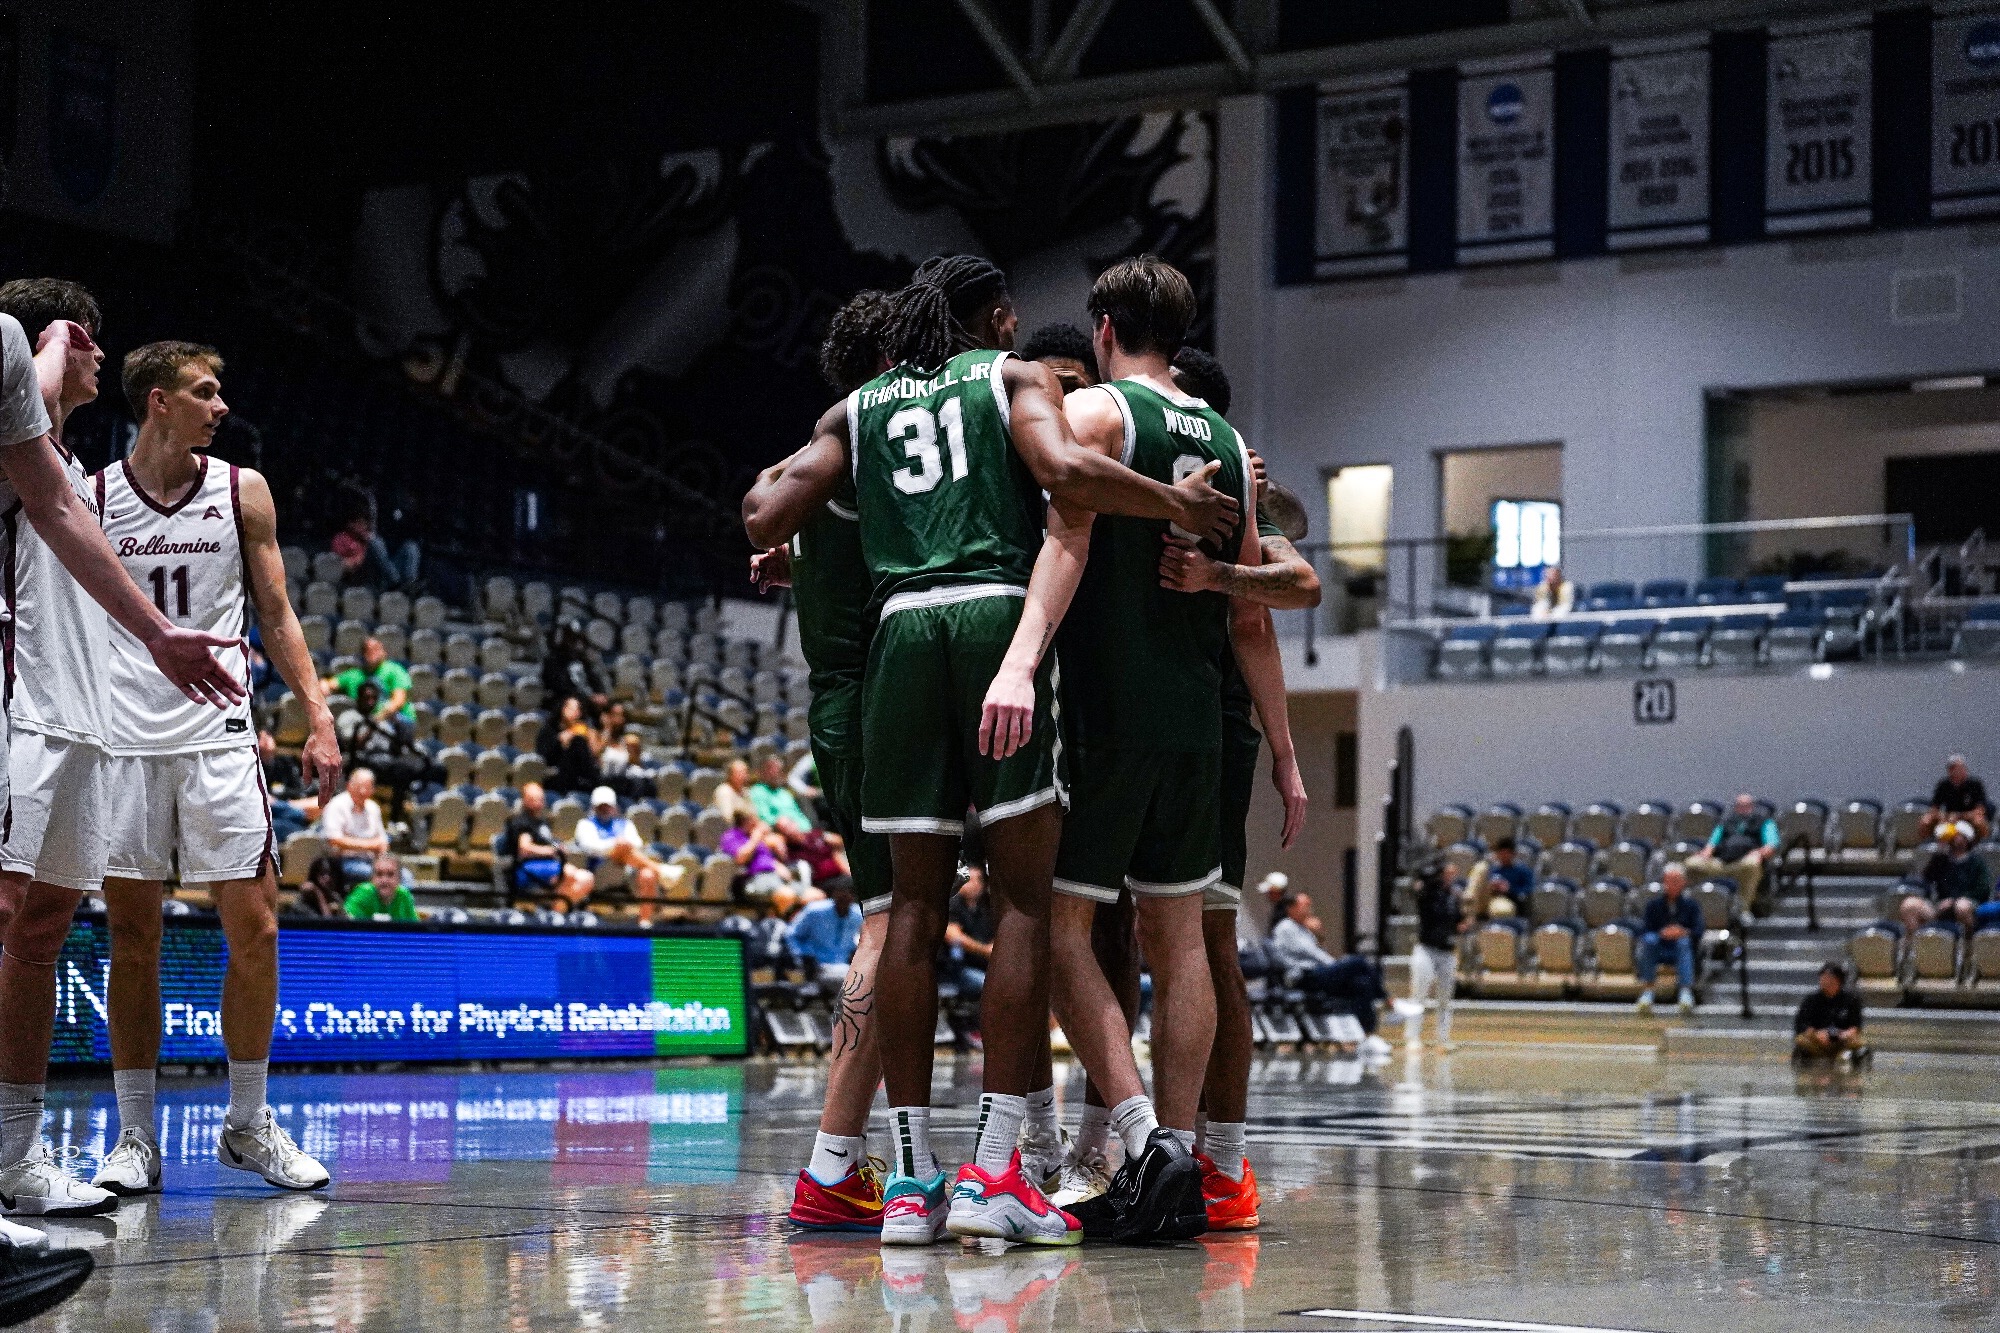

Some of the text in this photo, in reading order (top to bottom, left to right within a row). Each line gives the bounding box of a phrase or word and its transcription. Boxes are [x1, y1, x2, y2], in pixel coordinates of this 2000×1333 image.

[1786, 136, 1855, 185] 2015
[862, 370, 959, 410] THIRDKILL
[1163, 407, 1212, 442] WOOD
[886, 396, 969, 495] 31
[118, 535, 221, 557] Bellarmine
[148, 565, 191, 618] 11
[1638, 683, 1670, 718] 20
[305, 1002, 405, 1036] Choice
[412, 1003, 453, 1033] for
[459, 1003, 563, 1038] Physical
[568, 1001, 730, 1032] Rehabilitation
